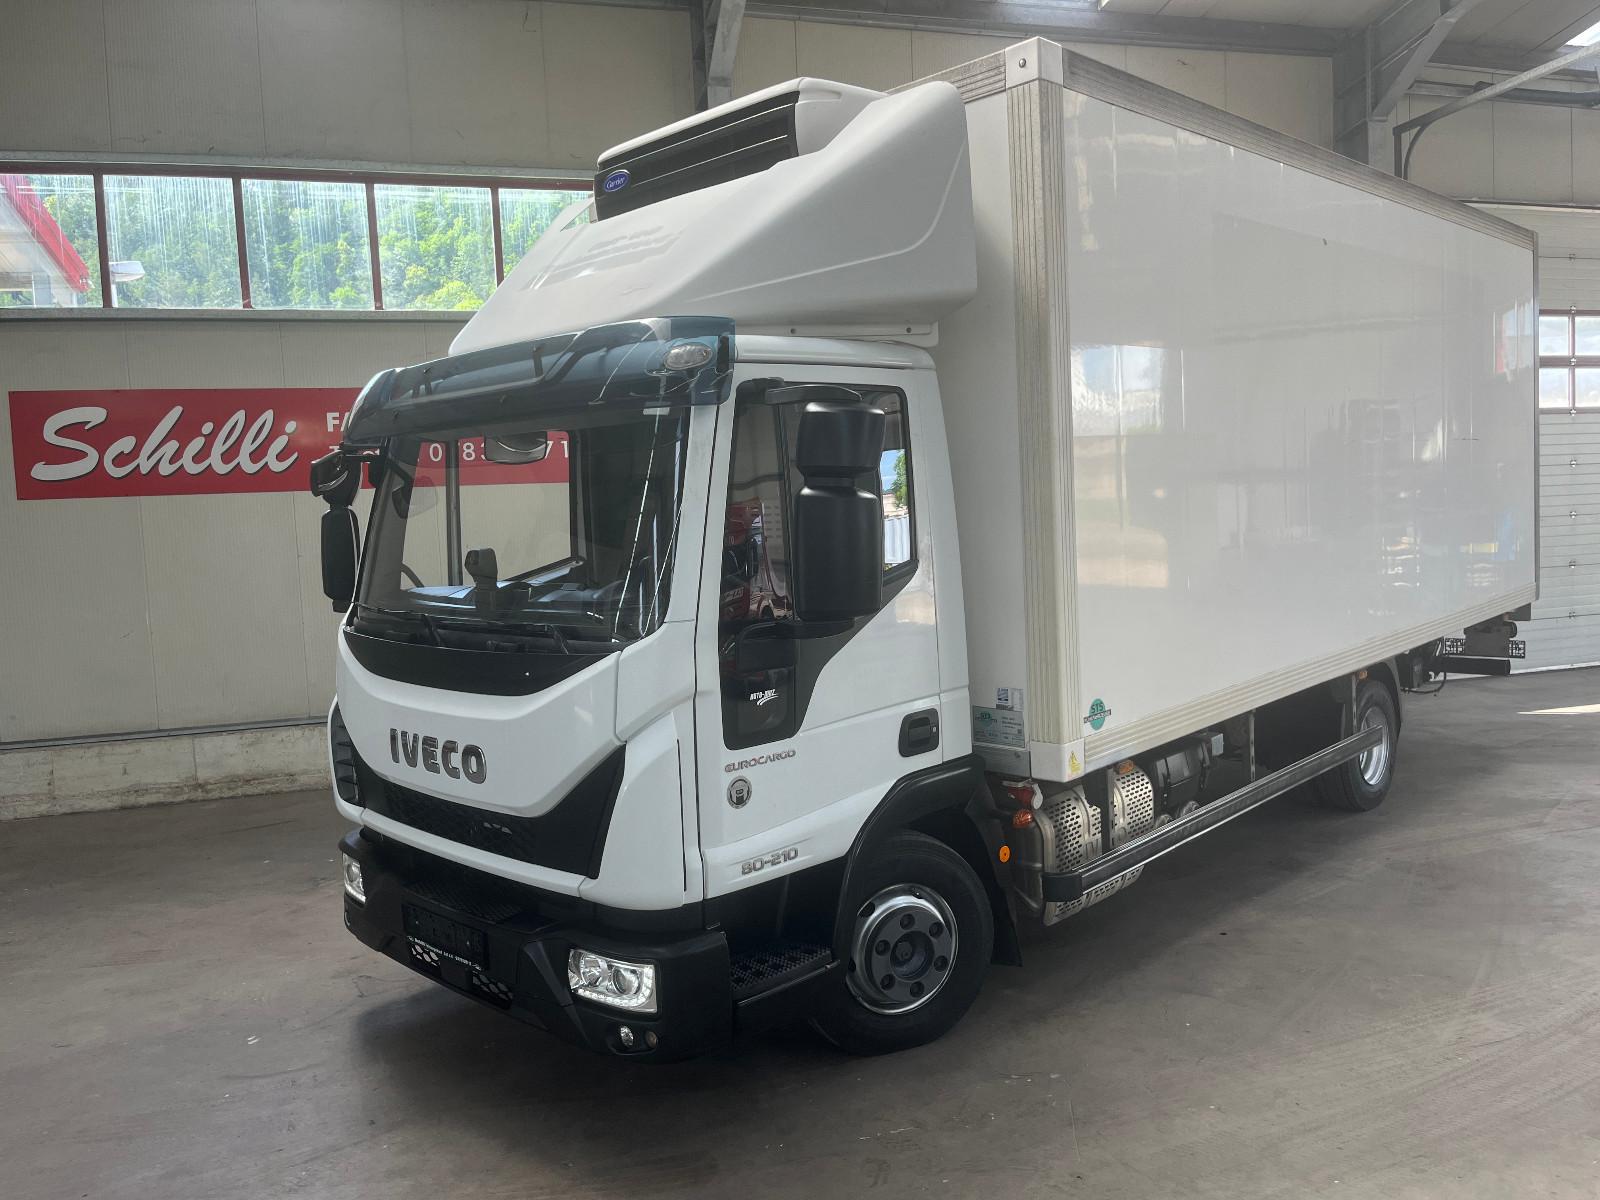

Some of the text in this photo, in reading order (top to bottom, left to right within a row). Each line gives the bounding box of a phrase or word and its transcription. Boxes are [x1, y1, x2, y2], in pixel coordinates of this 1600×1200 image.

[30, 405, 299, 481] Schilli
[389, 727, 487, 784] IVECO
[724, 750, 796, 773] EUROCARGO
[741, 846, 799, 875] 80-210
